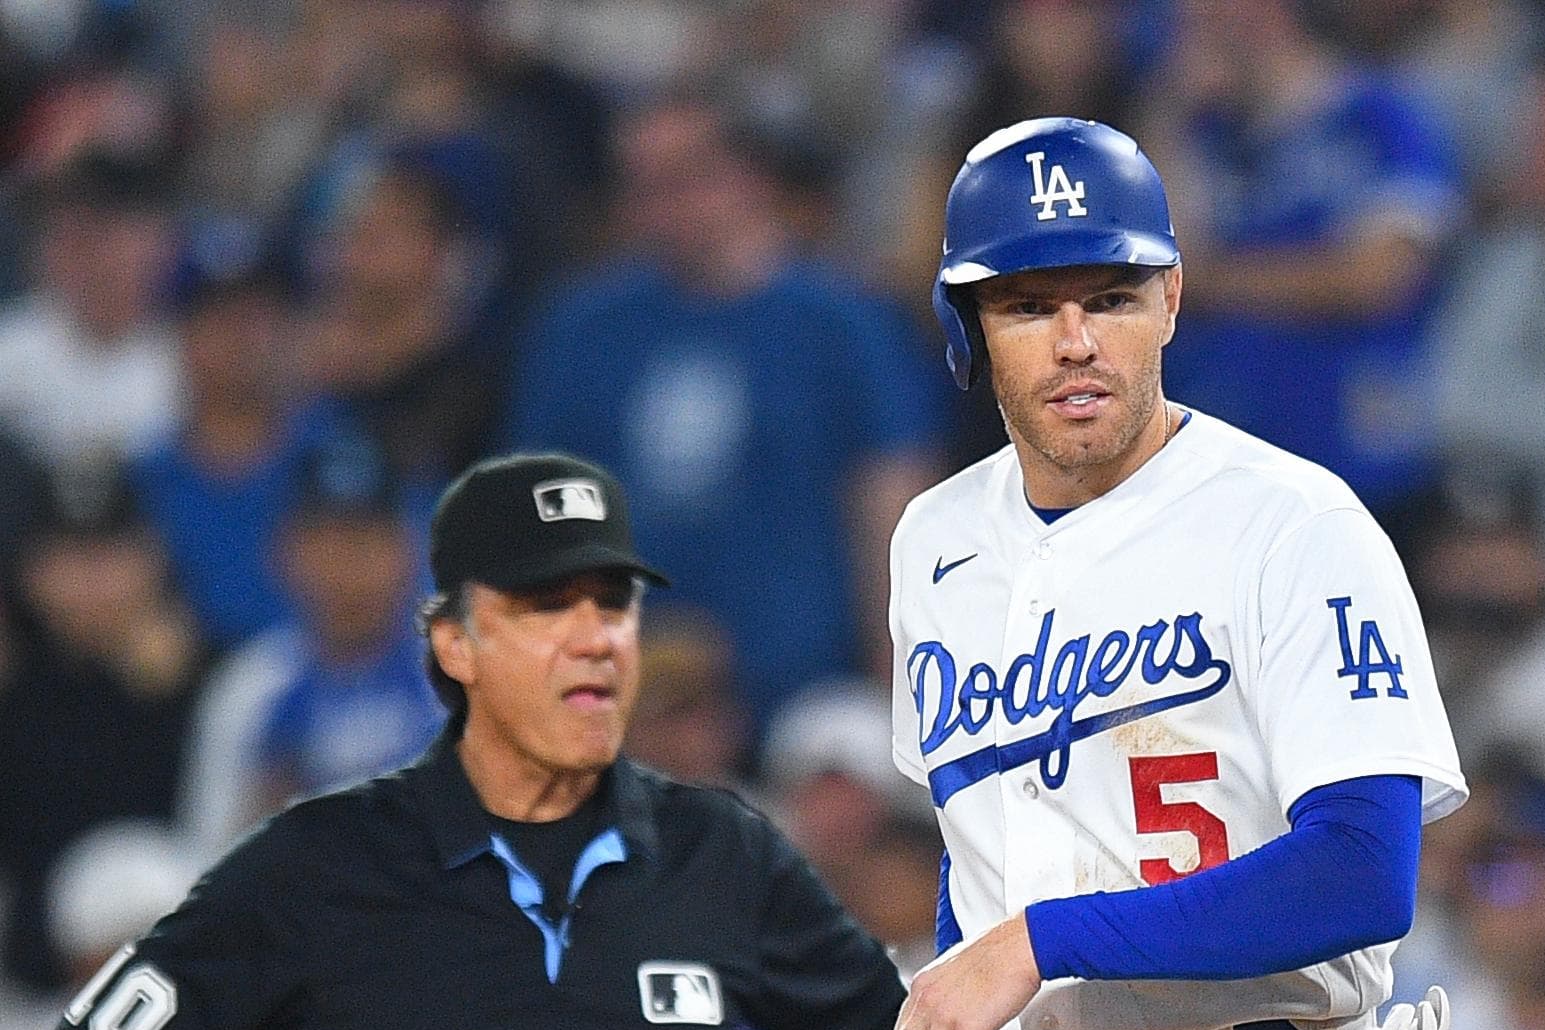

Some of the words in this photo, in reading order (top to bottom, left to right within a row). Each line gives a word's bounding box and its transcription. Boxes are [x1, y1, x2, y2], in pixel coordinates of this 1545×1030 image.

[1025, 151, 1088, 221] LA
[907, 608, 1231, 792] Dodgers
[1326, 596, 1409, 700] LA
[1128, 751, 1230, 887] 5
